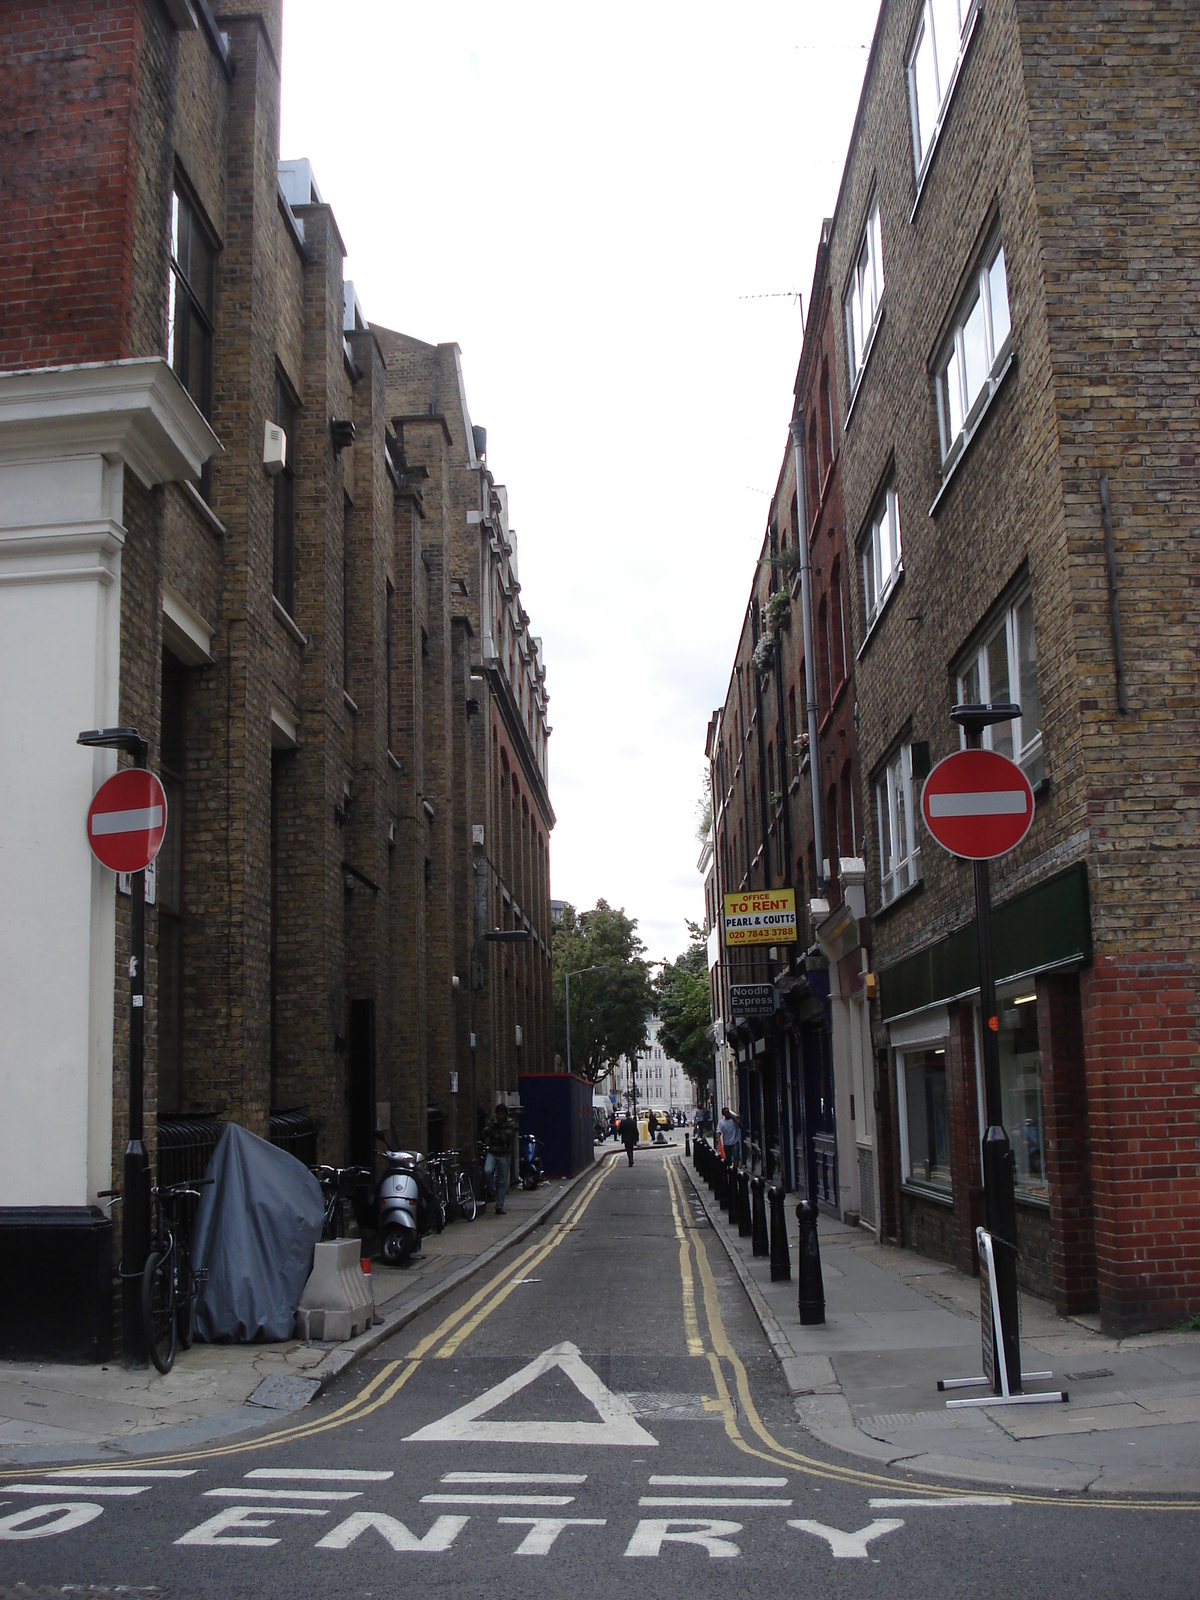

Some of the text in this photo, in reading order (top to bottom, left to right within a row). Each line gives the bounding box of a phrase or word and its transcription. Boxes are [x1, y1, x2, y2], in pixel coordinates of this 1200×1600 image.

[743, 893, 770, 902] OFFICE
[730, 899, 789, 913] TO RENT
[726, 914, 795, 928] PEARL & COUTTS
[729, 927, 794, 939] 020 7843 3788
[733, 986, 769, 996] Noodle
[731, 996, 773, 1007] Express
[0, 1501, 906, 1558] O ENTRY
